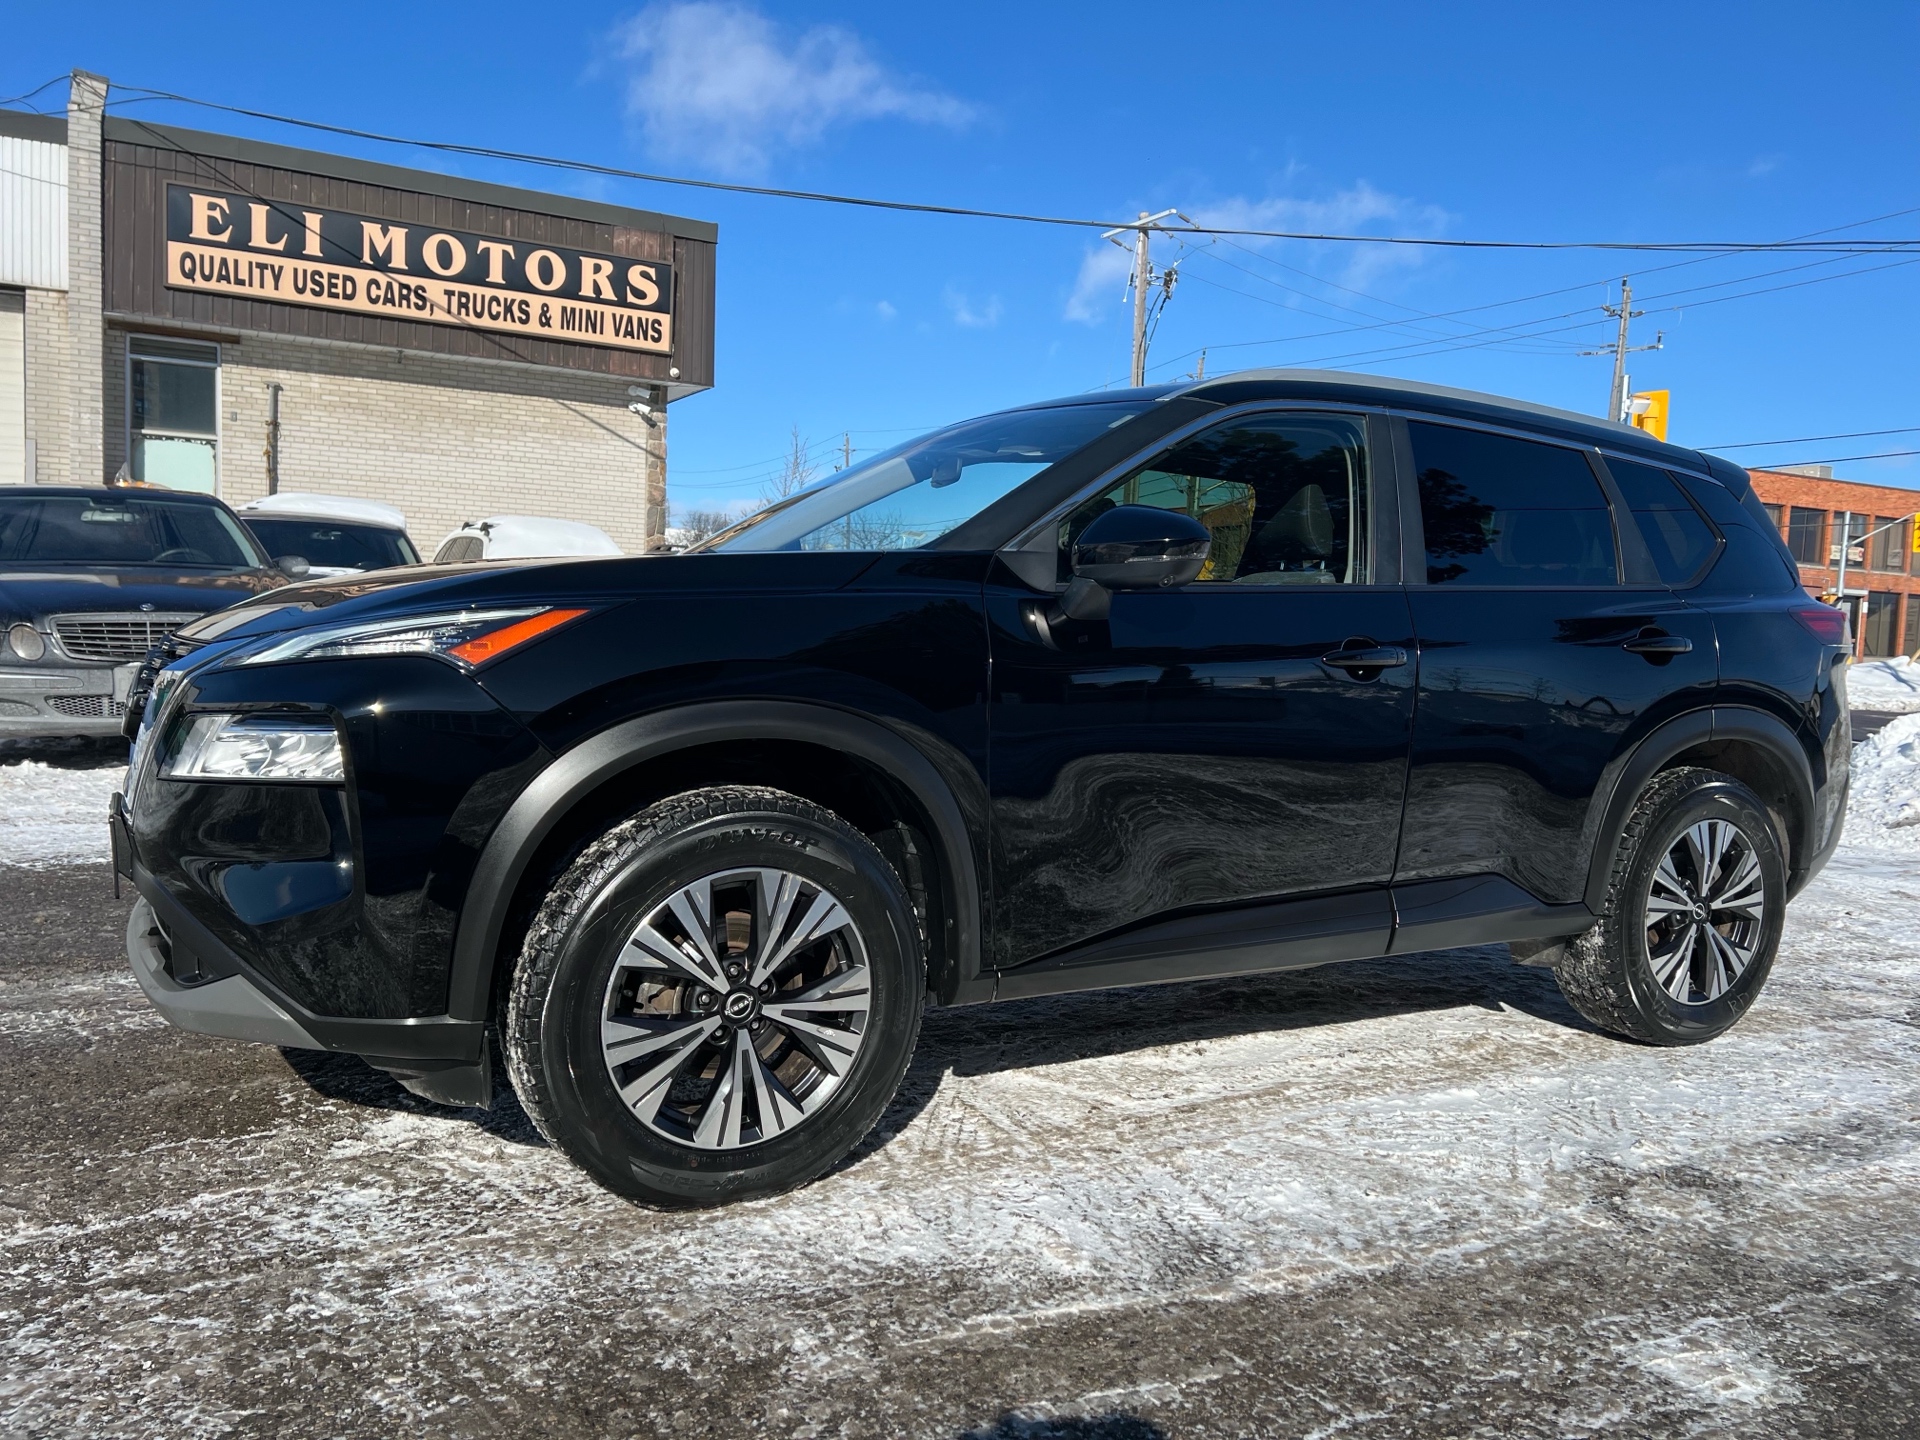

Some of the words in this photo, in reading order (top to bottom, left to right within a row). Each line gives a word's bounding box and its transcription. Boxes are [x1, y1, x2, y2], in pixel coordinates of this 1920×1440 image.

[189, 193, 323, 257] ELI
[360, 221, 659, 306] MOTORS
[180, 251, 284, 291] QUALITY
[293, 267, 357, 301] USED
[366, 278, 434, 316] CARS,
[444, 289, 531, 325] TRUCKS
[538, 302, 552, 328] &
[560, 305, 604, 335] MINI
[612, 312, 662, 343] VANS
[695, 828, 820, 854] DUNLOP
